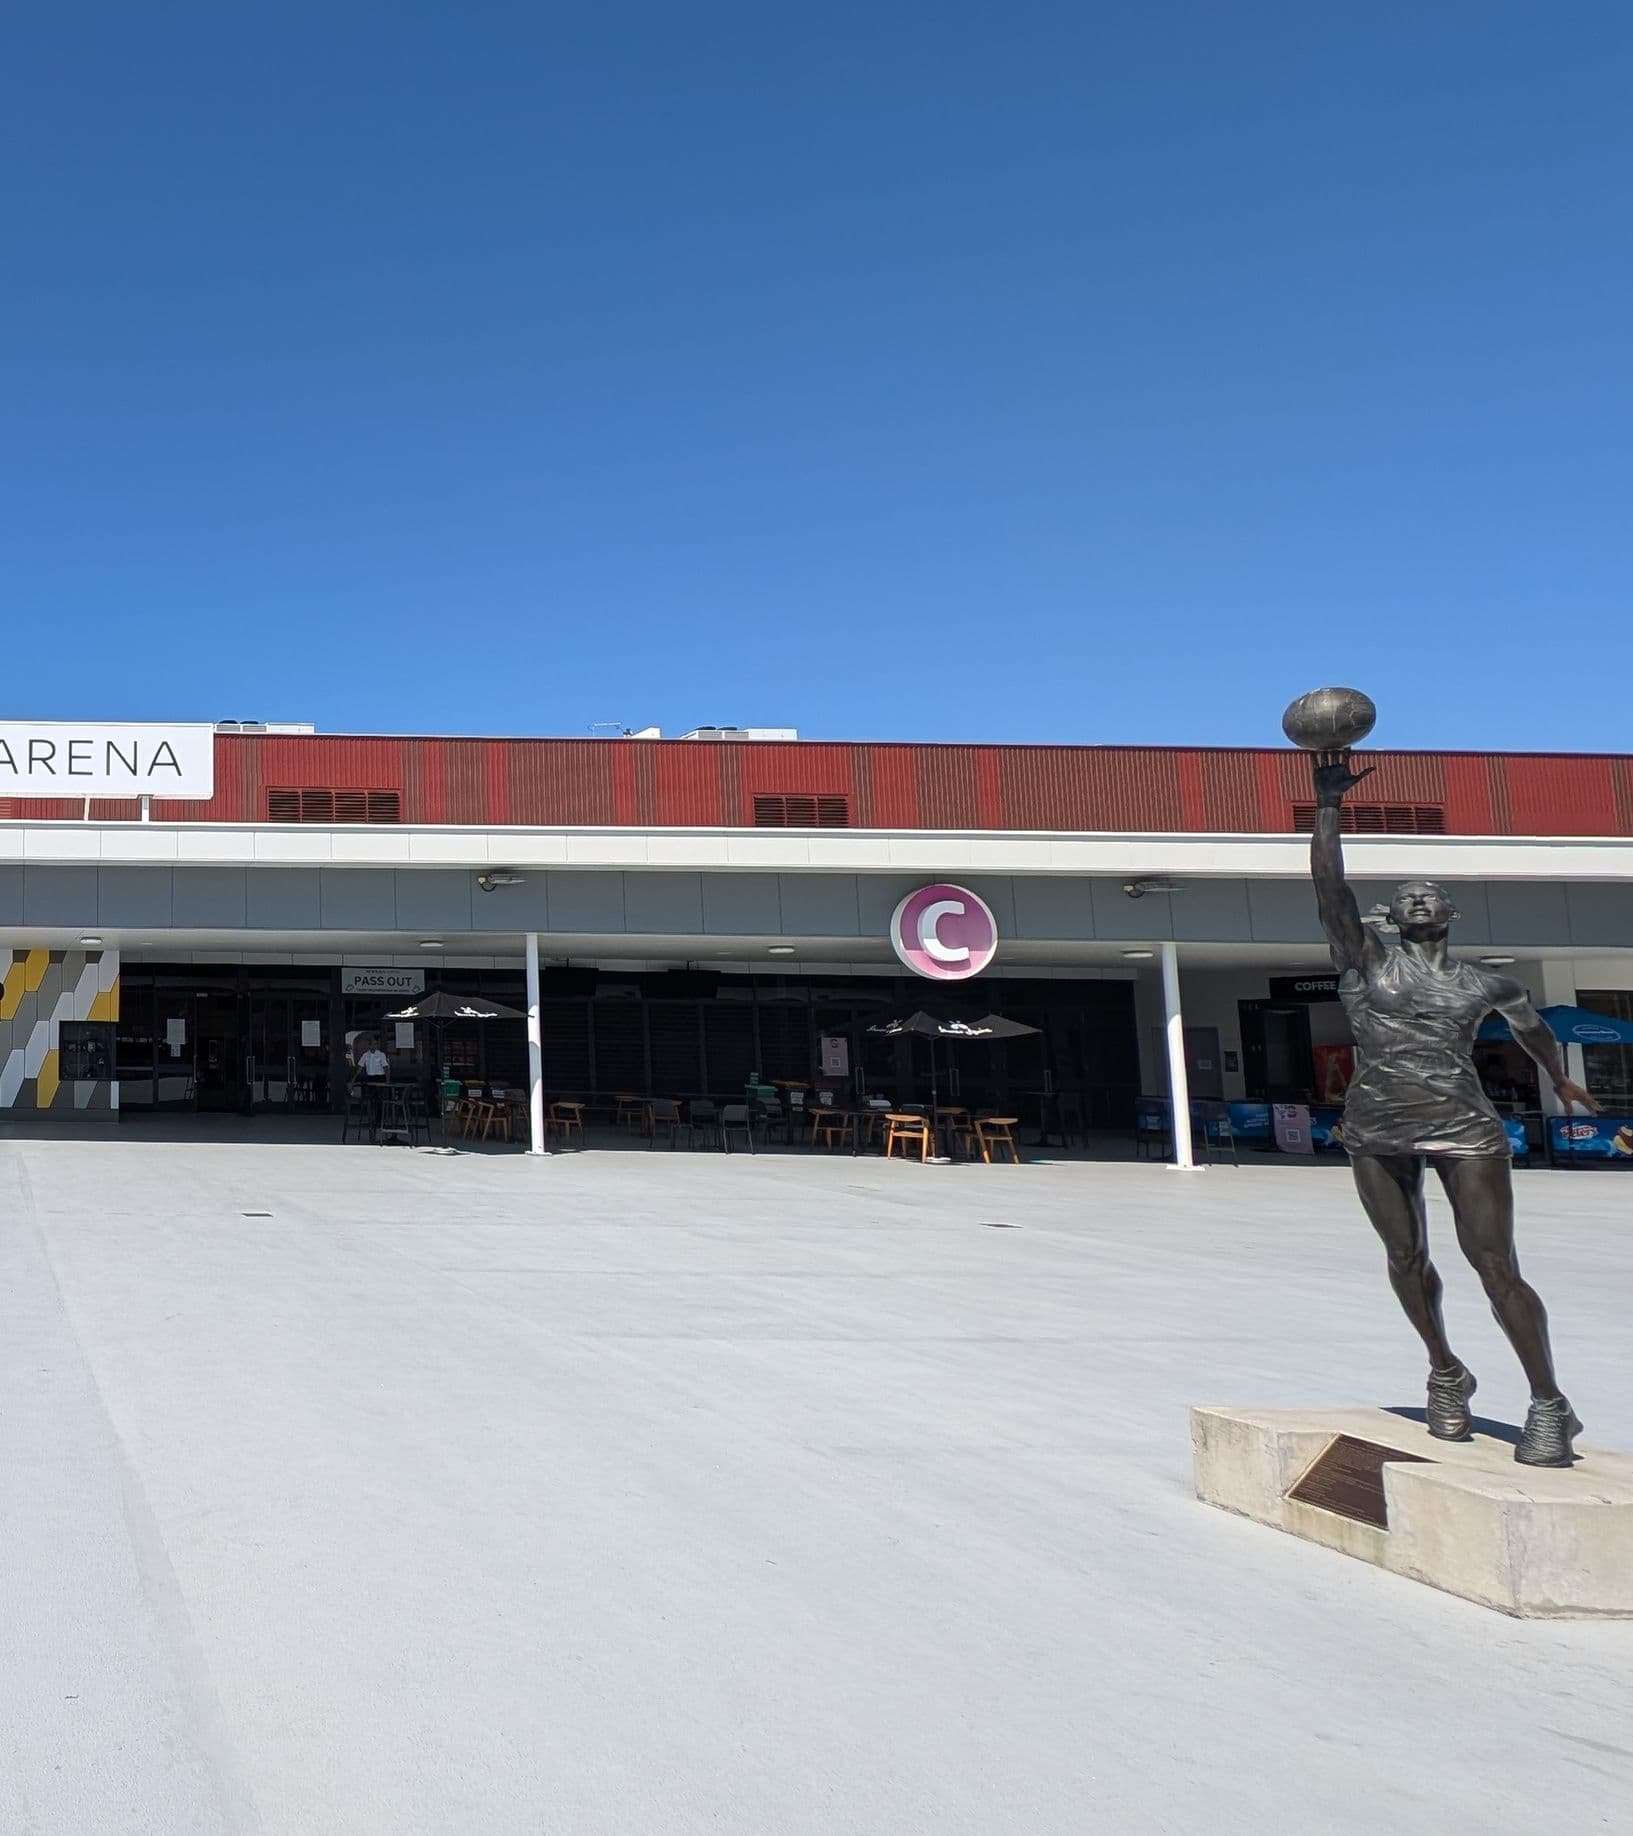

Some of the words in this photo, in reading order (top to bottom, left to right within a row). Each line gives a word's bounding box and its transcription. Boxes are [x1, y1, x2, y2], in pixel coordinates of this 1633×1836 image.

[917, 900, 970, 962] C
[354, 976, 385, 986] PASS
[386, 976, 412, 987] OUT
[1294, 980, 1337, 992] COFFEE
